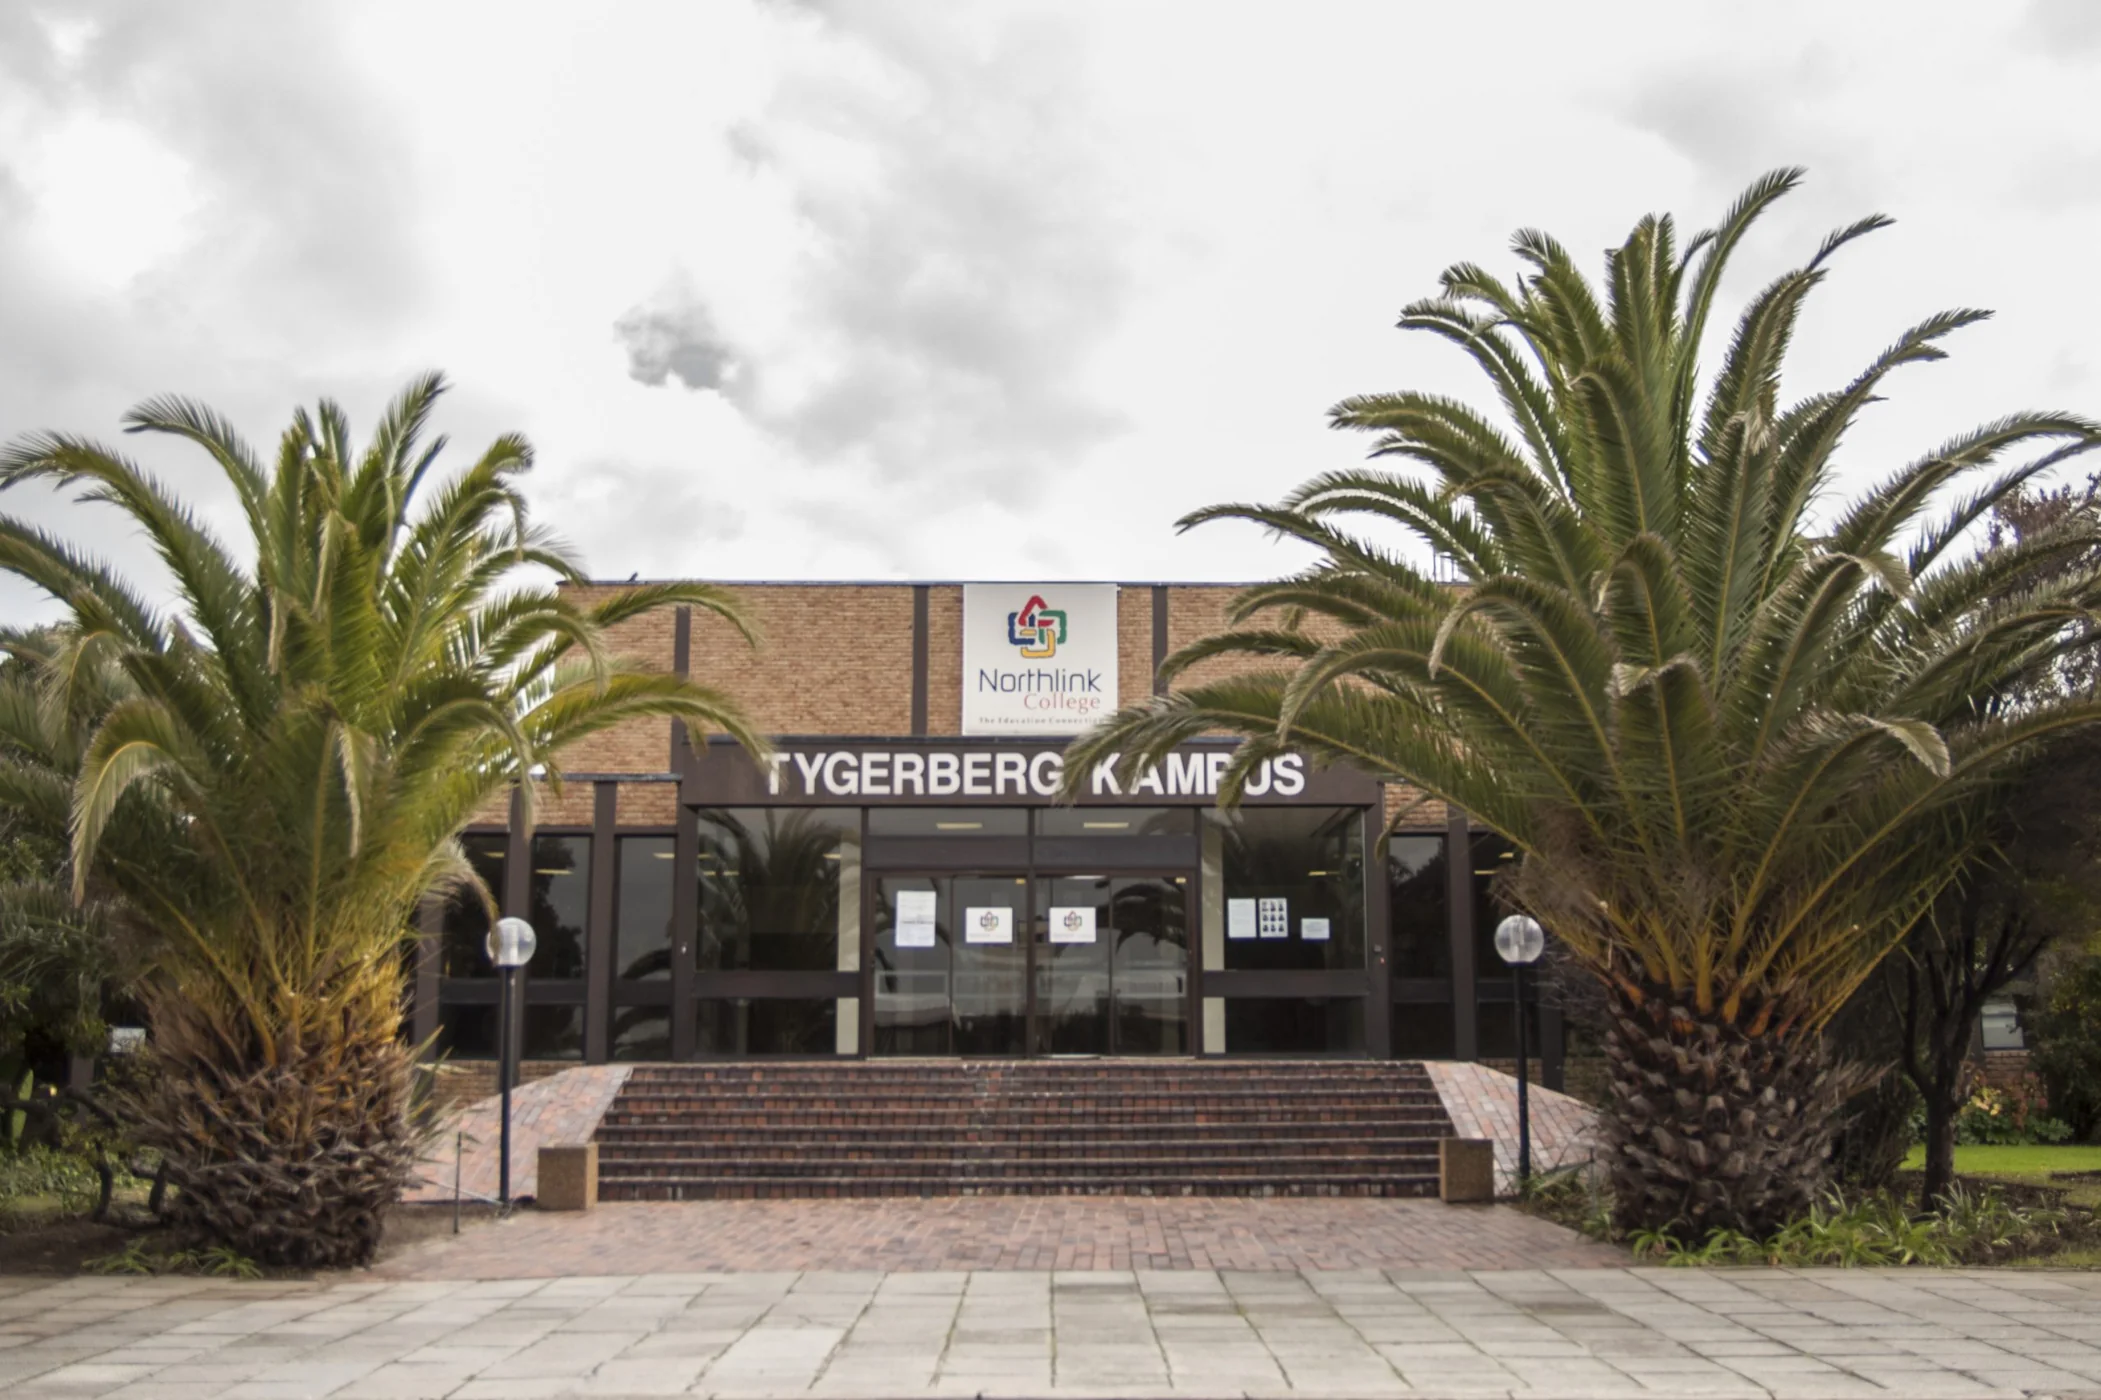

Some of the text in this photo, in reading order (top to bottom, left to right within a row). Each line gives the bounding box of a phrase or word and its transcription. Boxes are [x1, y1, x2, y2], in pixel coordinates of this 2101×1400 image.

[979, 668, 1101, 692] Northlink
[1023, 693, 1101, 714] College
[979, 716, 995, 724] The
[761, 751, 1066, 796] TYGERBERG
